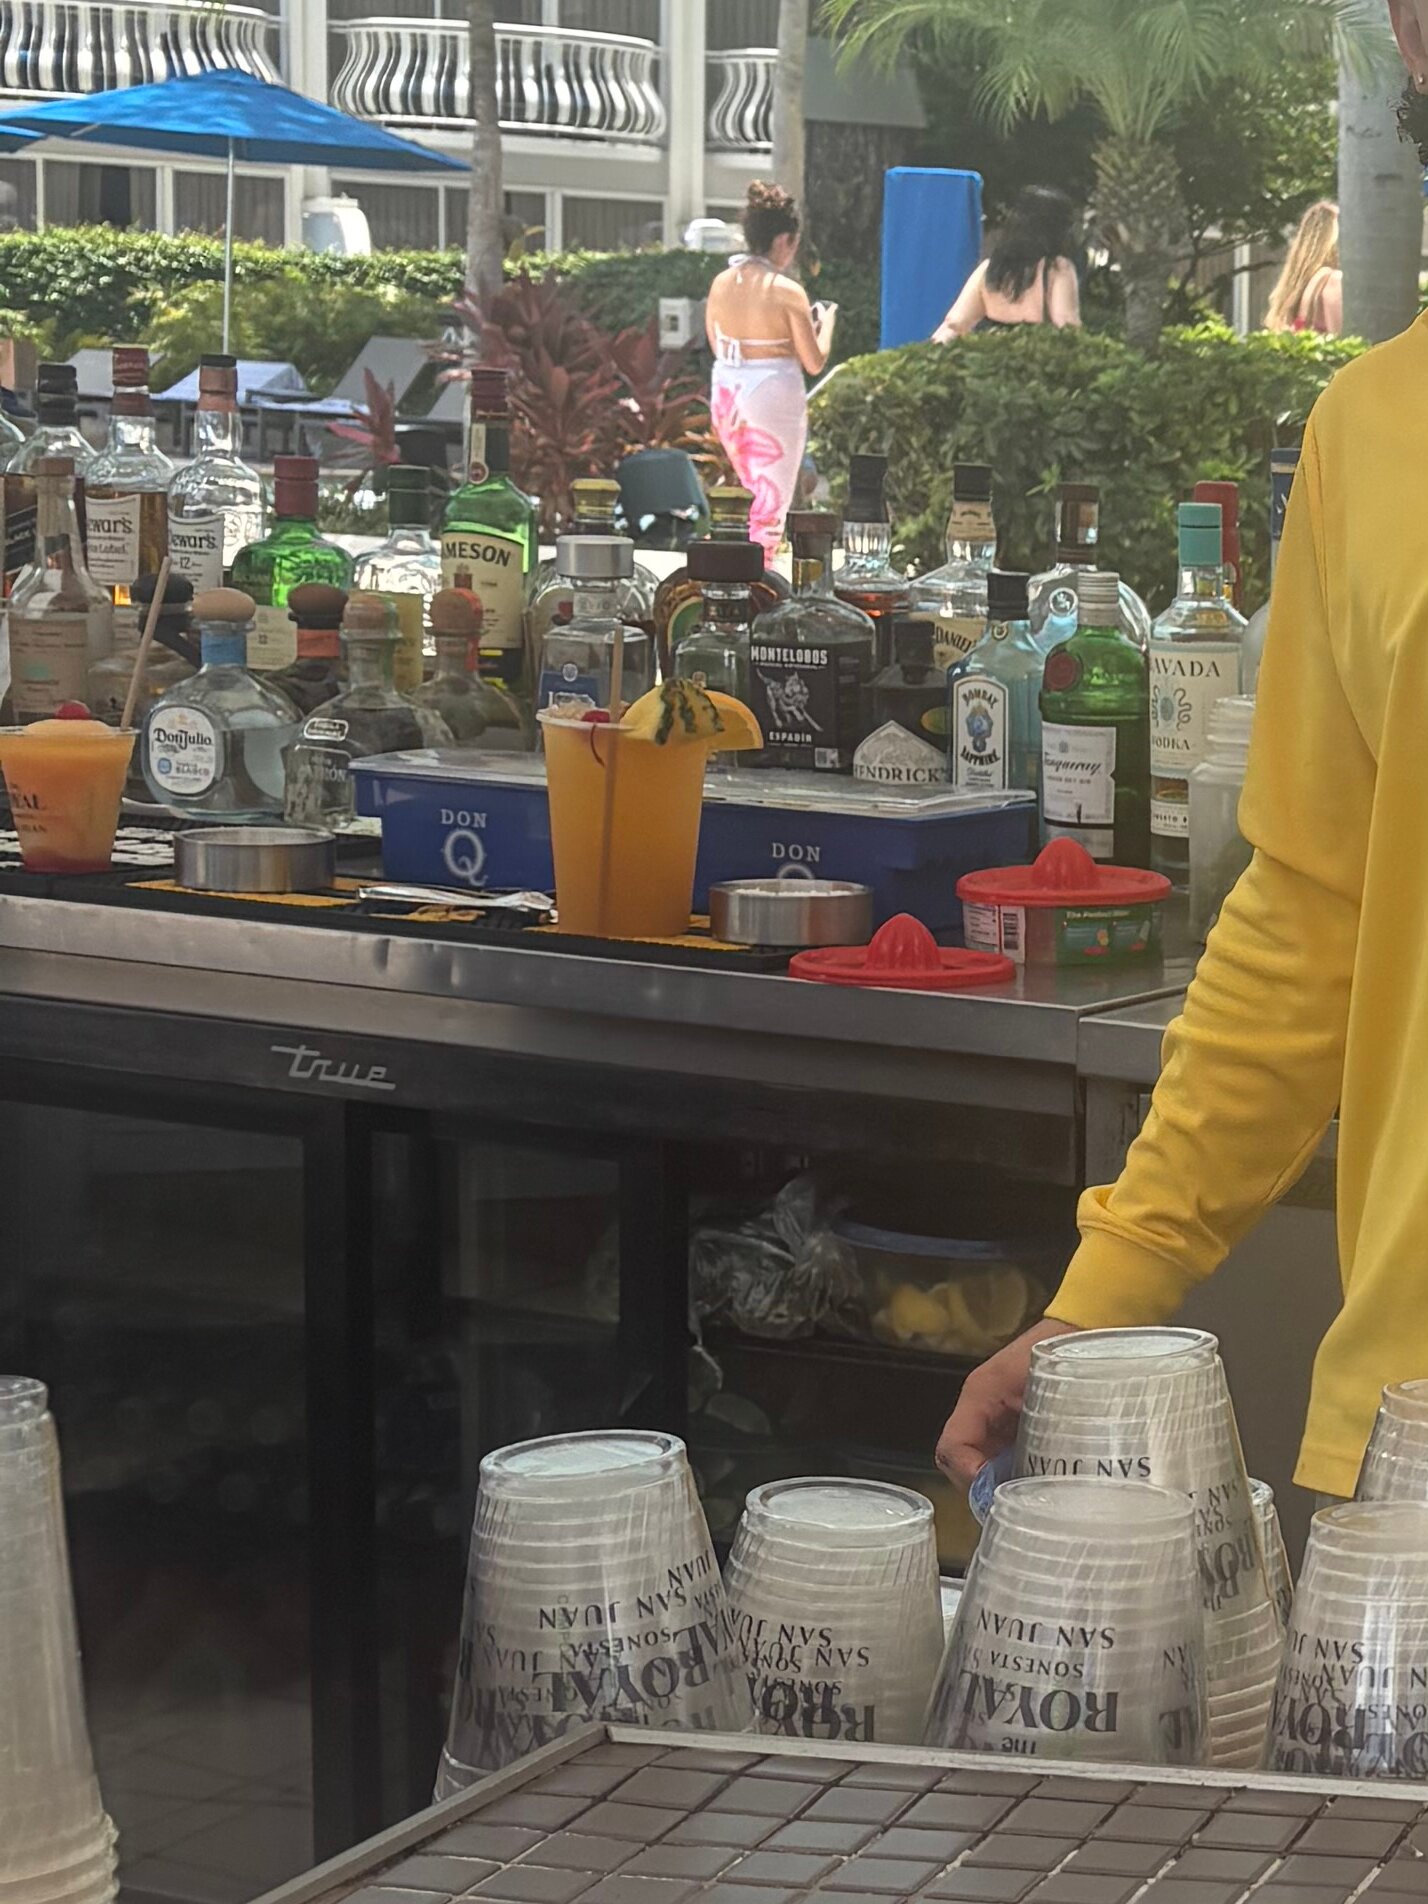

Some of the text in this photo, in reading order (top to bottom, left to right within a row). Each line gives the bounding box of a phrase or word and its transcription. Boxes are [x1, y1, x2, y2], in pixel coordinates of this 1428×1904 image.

[170, 532, 217, 550] ewar's
[441, 541, 513, 568] AMESON
[751, 645, 828, 665] MONTELOBOS
[440, 808, 488, 829] DON
[442, 827, 490, 888] Q
[772, 842, 822, 862] DON
[1097, 1455, 1152, 1478] SAN
[539, 1585, 687, 1631] SAN JUAN
[778, 1623, 832, 1648] SAN
[975, 1608, 1116, 1650] SAN JUAN
[815, 1646, 871, 1668] SAN
[1314, 1640, 1365, 1664] SAN
[990, 1650, 1085, 1679] SONESTA
[958, 1668, 1120, 1734] ROYAL
